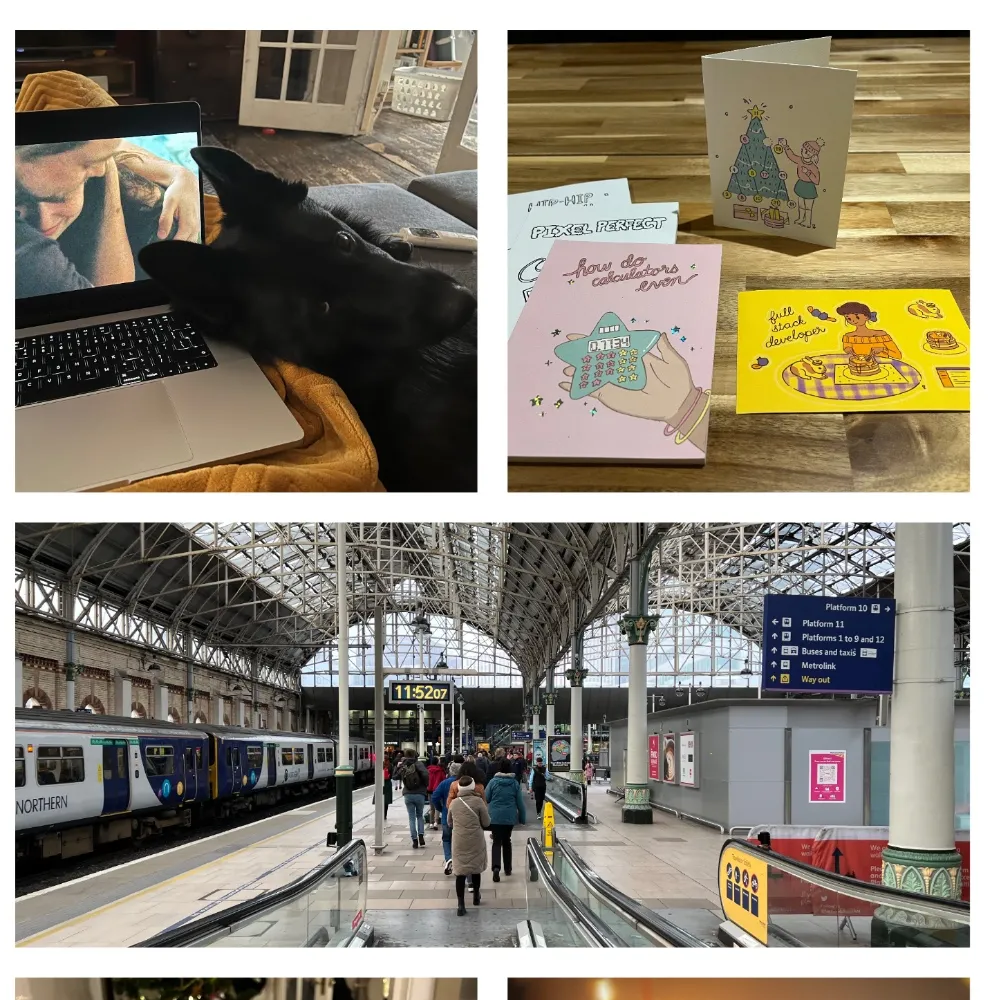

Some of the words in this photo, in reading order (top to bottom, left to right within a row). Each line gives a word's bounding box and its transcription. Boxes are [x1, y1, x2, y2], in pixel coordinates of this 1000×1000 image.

[530, 223, 593, 239] PIXEL
[596, 217, 667, 232] PERFECT
[563, 258, 612, 278] how
[621, 254, 647, 268] do
[591, 260, 679, 287] calculators
[635, 274, 698, 292] even
[769, 306, 794, 324] full
[772, 315, 806, 332] stack
[765, 326, 826, 348] developer
[825, 603, 857, 612] Platform
[858, 604, 868, 612] 10
[802, 620, 834, 628] Platform
[802, 633, 837, 642] Platforms
[838, 634, 843, 642] 1
[801, 648, 823, 656] Buses
[824, 648, 837, 656] and
[801, 661, 836, 670] Metrolink
[801, 676, 817, 684] Way
[15, 795, 68, 815] NORTHERN
